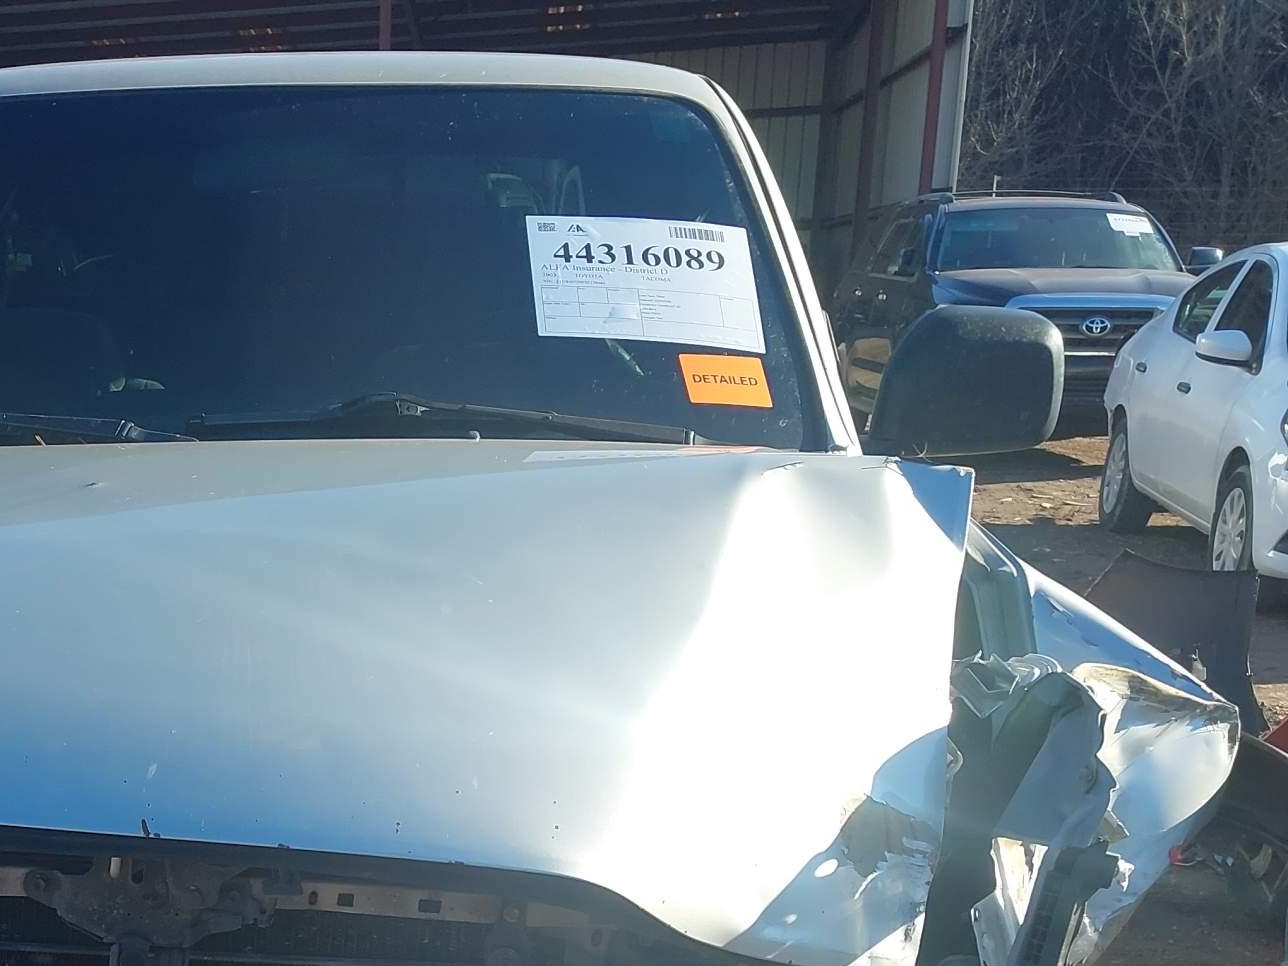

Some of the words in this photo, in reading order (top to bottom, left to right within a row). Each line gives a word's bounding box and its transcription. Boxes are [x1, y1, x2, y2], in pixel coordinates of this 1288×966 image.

[553, 241, 725, 271] 44316089
[572, 264, 616, 273] Insurance
[624, 266, 657, 275] District
[692, 373, 758, 387] DETAILED
